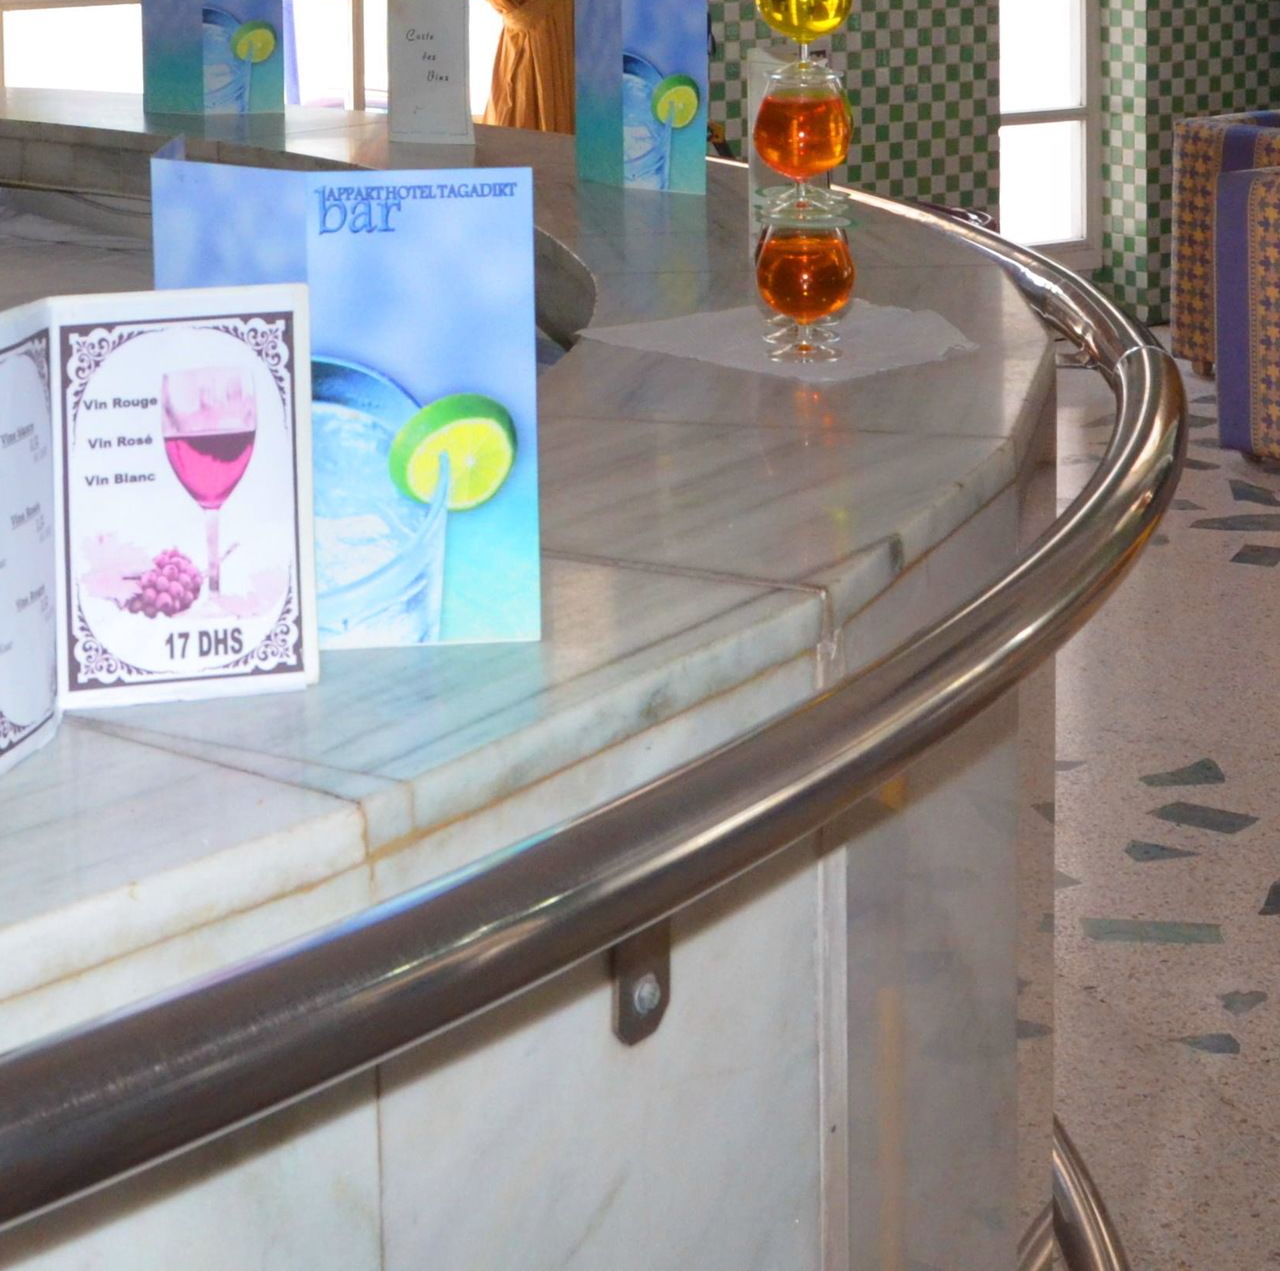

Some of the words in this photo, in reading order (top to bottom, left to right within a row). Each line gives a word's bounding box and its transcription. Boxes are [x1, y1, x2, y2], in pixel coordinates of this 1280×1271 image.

[325, 186, 385, 202] APPART
[385, 184, 437, 201] HOTEL
[314, 186, 402, 236] bar
[83, 399, 108, 411] Vin
[112, 397, 158, 409] Rouge
[87, 438, 112, 450] Vin
[117, 434, 153, 447] Rosé
[85, 474, 109, 487] Vin
[114, 472, 156, 484] Blanc
[165, 631, 190, 660] 17
[198, 627, 244, 657] DHS
